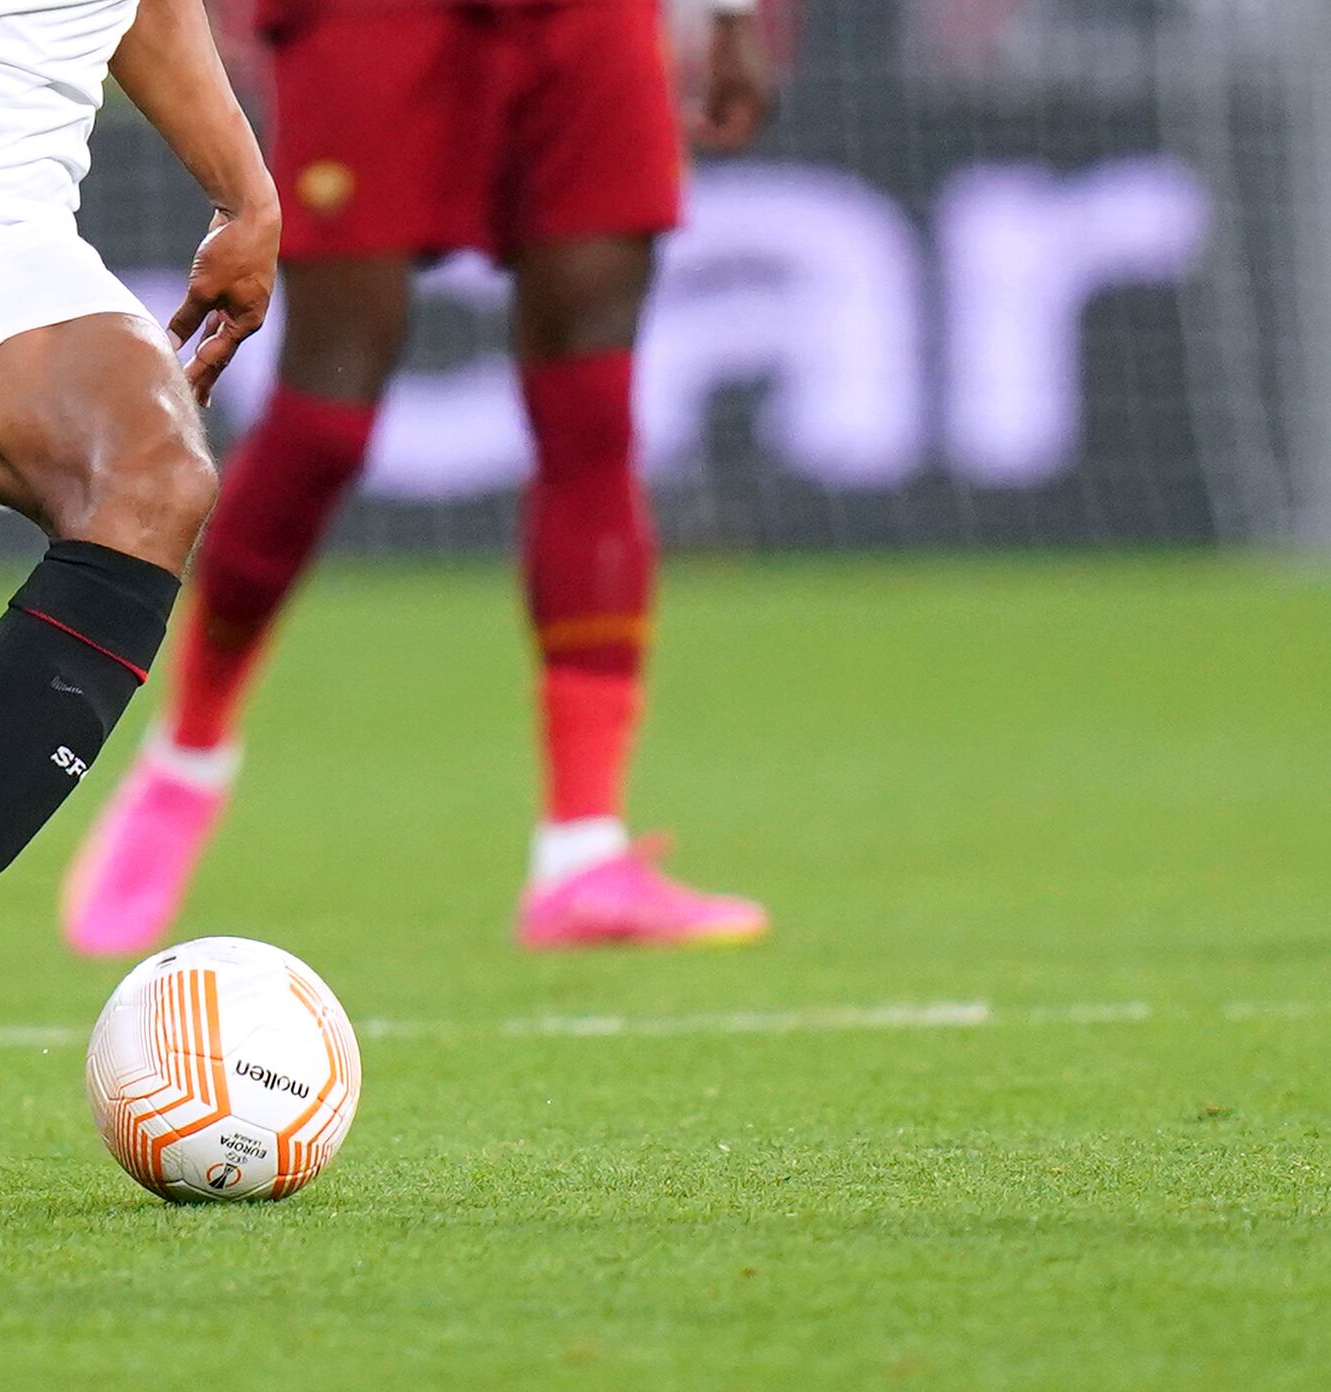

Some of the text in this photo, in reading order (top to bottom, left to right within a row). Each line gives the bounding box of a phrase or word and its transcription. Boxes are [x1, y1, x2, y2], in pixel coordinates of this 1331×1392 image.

[50, 745, 88, 783] SF
[235, 1059, 310, 1099] molten
[220, 1134, 268, 1160] EUROPA
